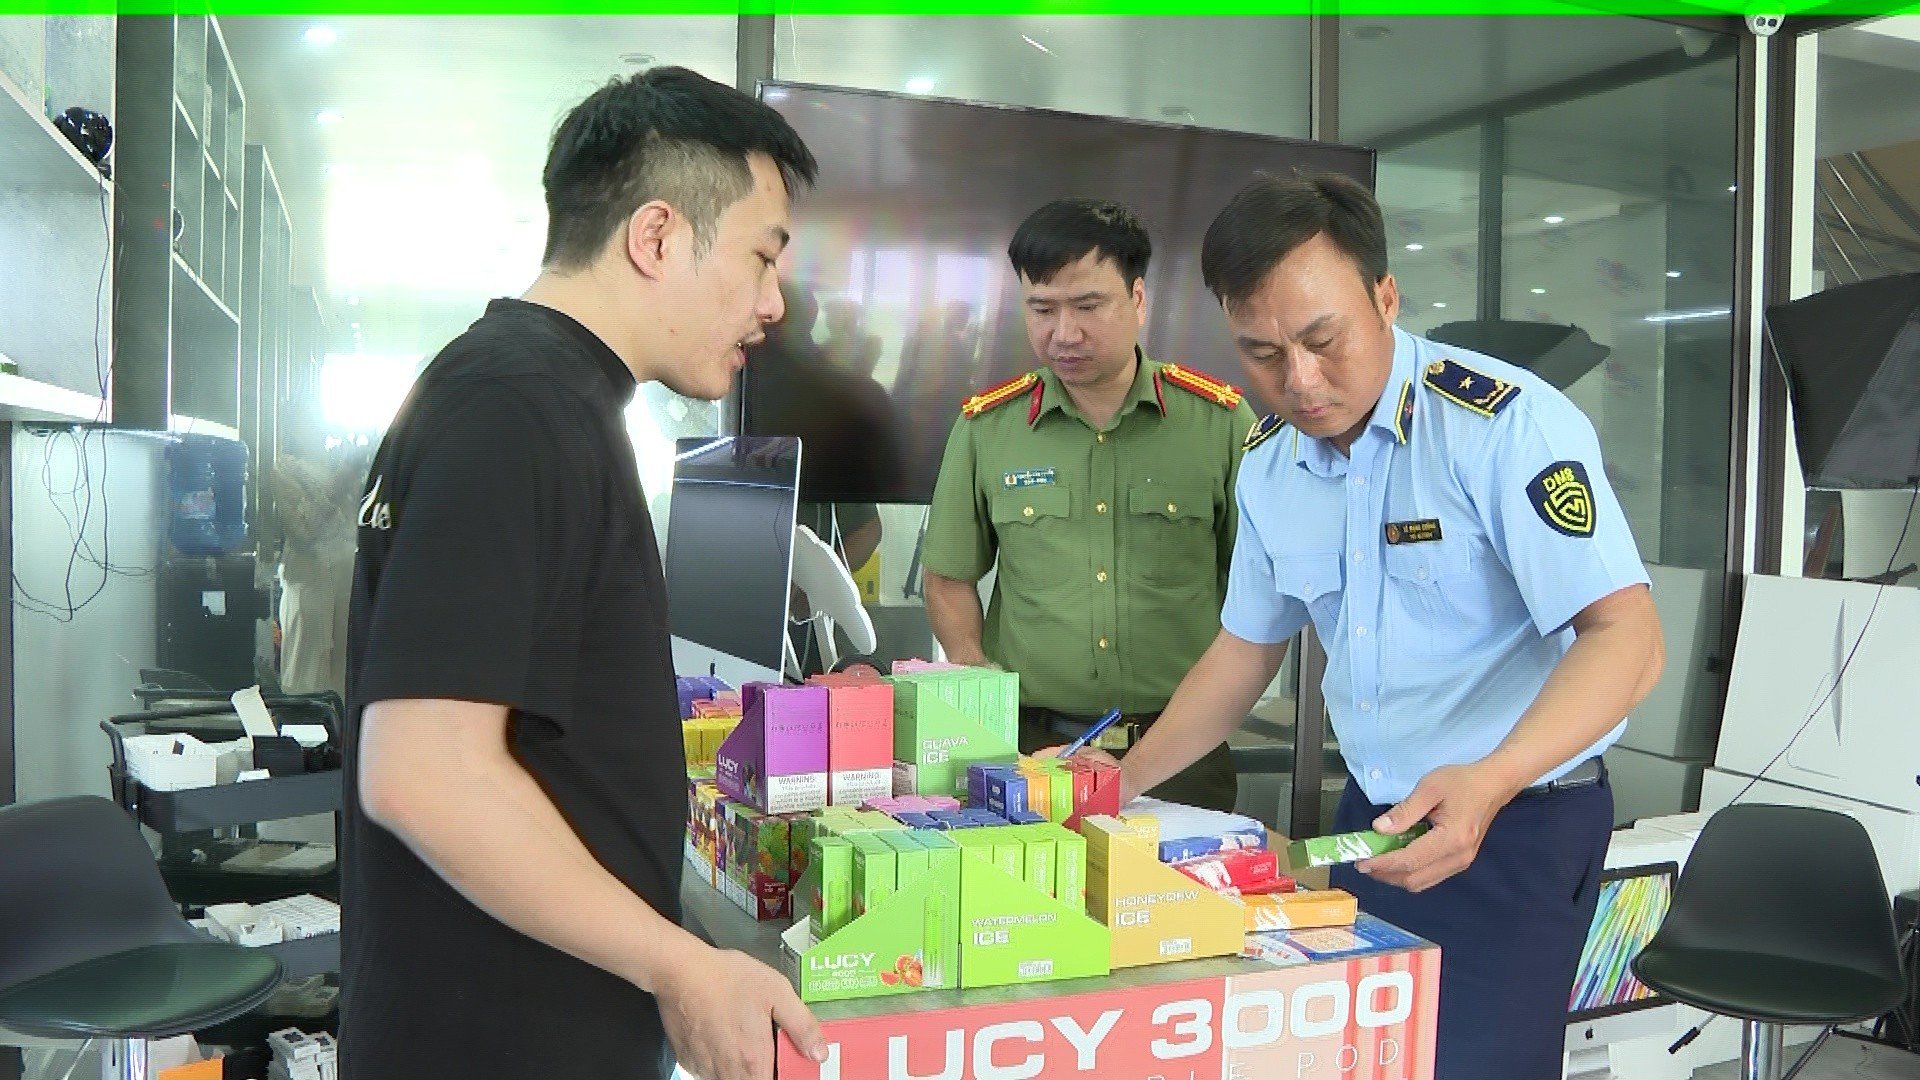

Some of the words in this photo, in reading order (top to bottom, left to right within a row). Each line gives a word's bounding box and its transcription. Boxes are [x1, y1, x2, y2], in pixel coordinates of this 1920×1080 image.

[922, 734, 969, 751] GUAVA
[718, 754, 739, 774] LUCY
[922, 751, 950, 765] ICE
[778, 775, 816, 785] WARNING
[843, 772, 881, 781] WARNING
[1115, 890, 1200, 907] HONEYDEW
[972, 913, 1057, 927] WATERMELON
[1115, 910, 1150, 926] ICE
[973, 930, 1010, 945] ICE
[811, 952, 877, 970] LUCY
[1150, 971, 1415, 1060] 3000
[1297, 1038, 1399, 1079] POD
